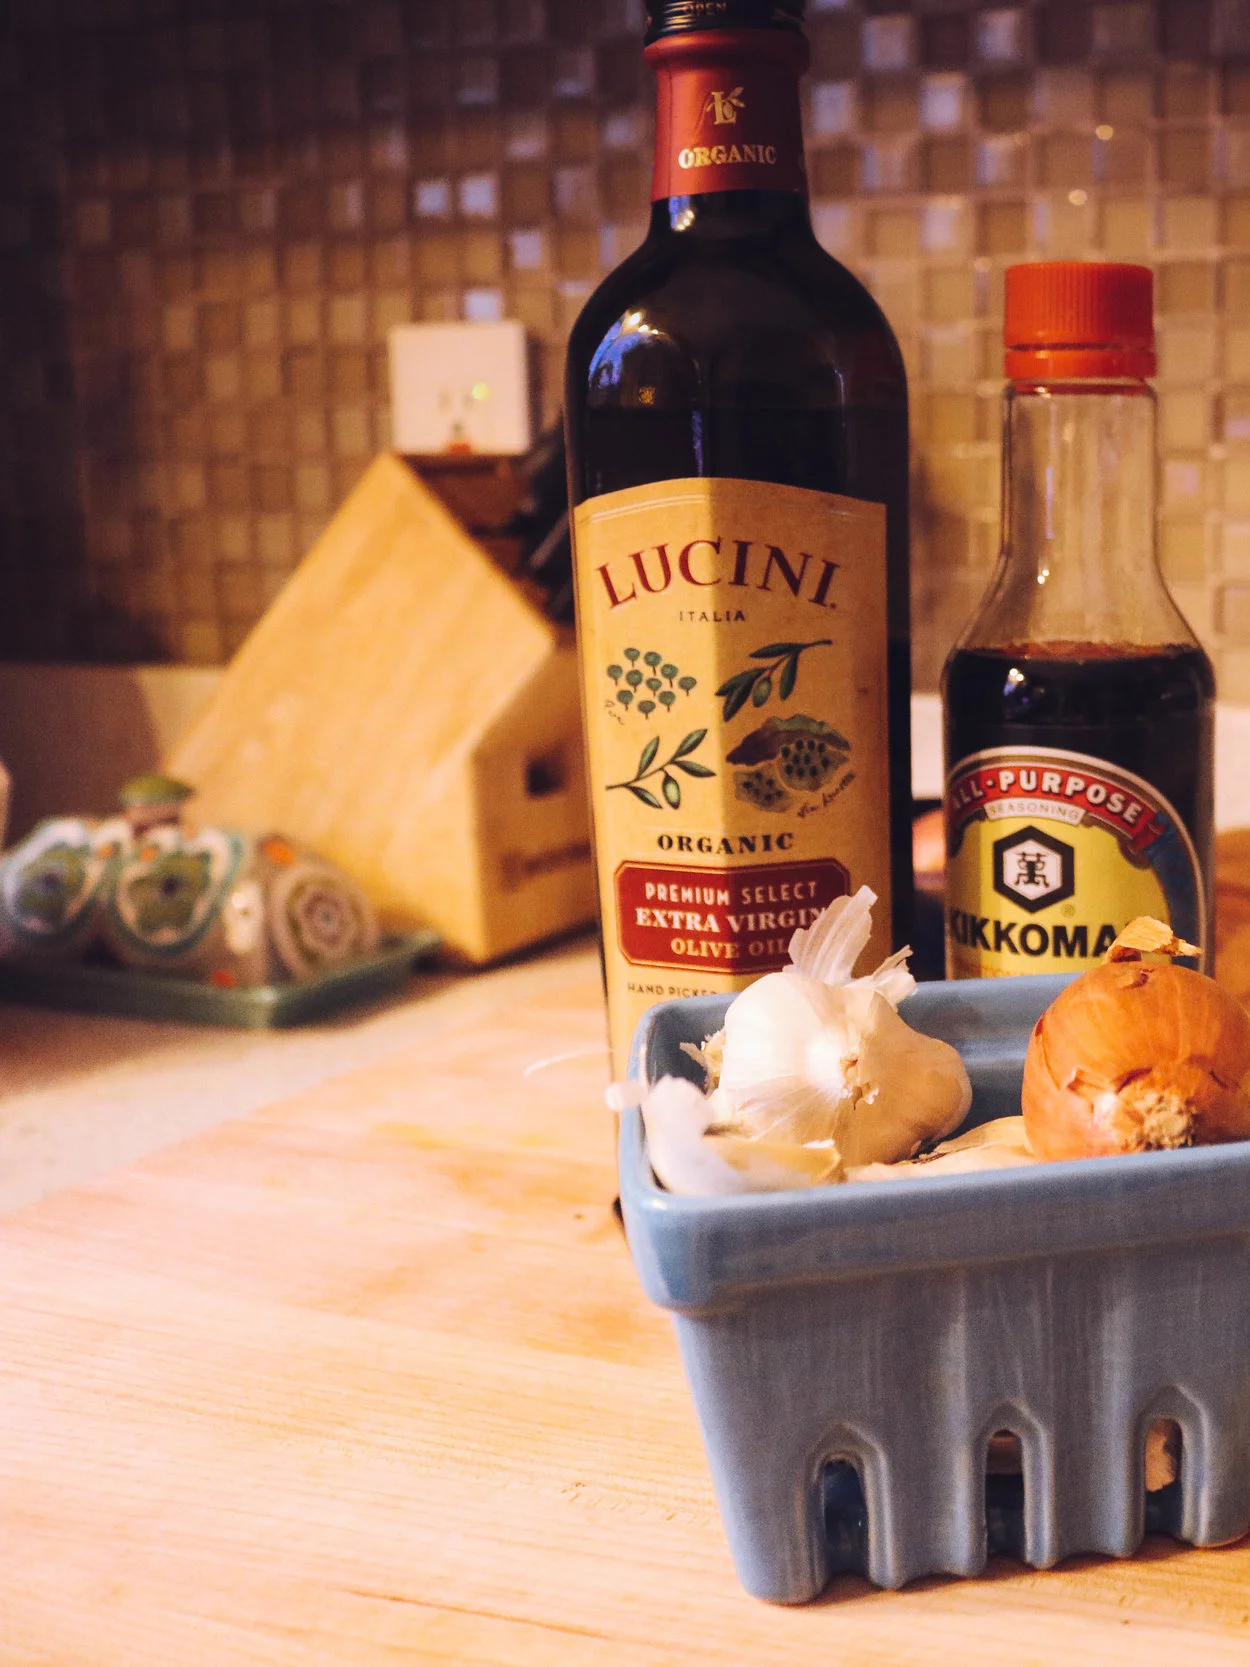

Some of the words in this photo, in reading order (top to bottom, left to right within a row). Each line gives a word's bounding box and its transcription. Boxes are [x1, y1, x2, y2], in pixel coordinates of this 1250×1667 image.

[678, 145, 776, 169] ORGANIC
[594, 536, 840, 610] LUCINI
[679, 610, 747, 622] ITALIA
[989, 802, 1078, 821] SEASONING
[657, 832, 794, 855] ORGANIC
[645, 883, 730, 905] PREMIUM
[742, 881, 817, 905] SELECT
[635, 907, 720, 933] EXTRA
[950, 910, 1118, 958] KIKKOMA
[670, 937, 739, 959] OLIVE
[749, 938, 789, 958] OIL
[628, 982, 664, 995] HAND
